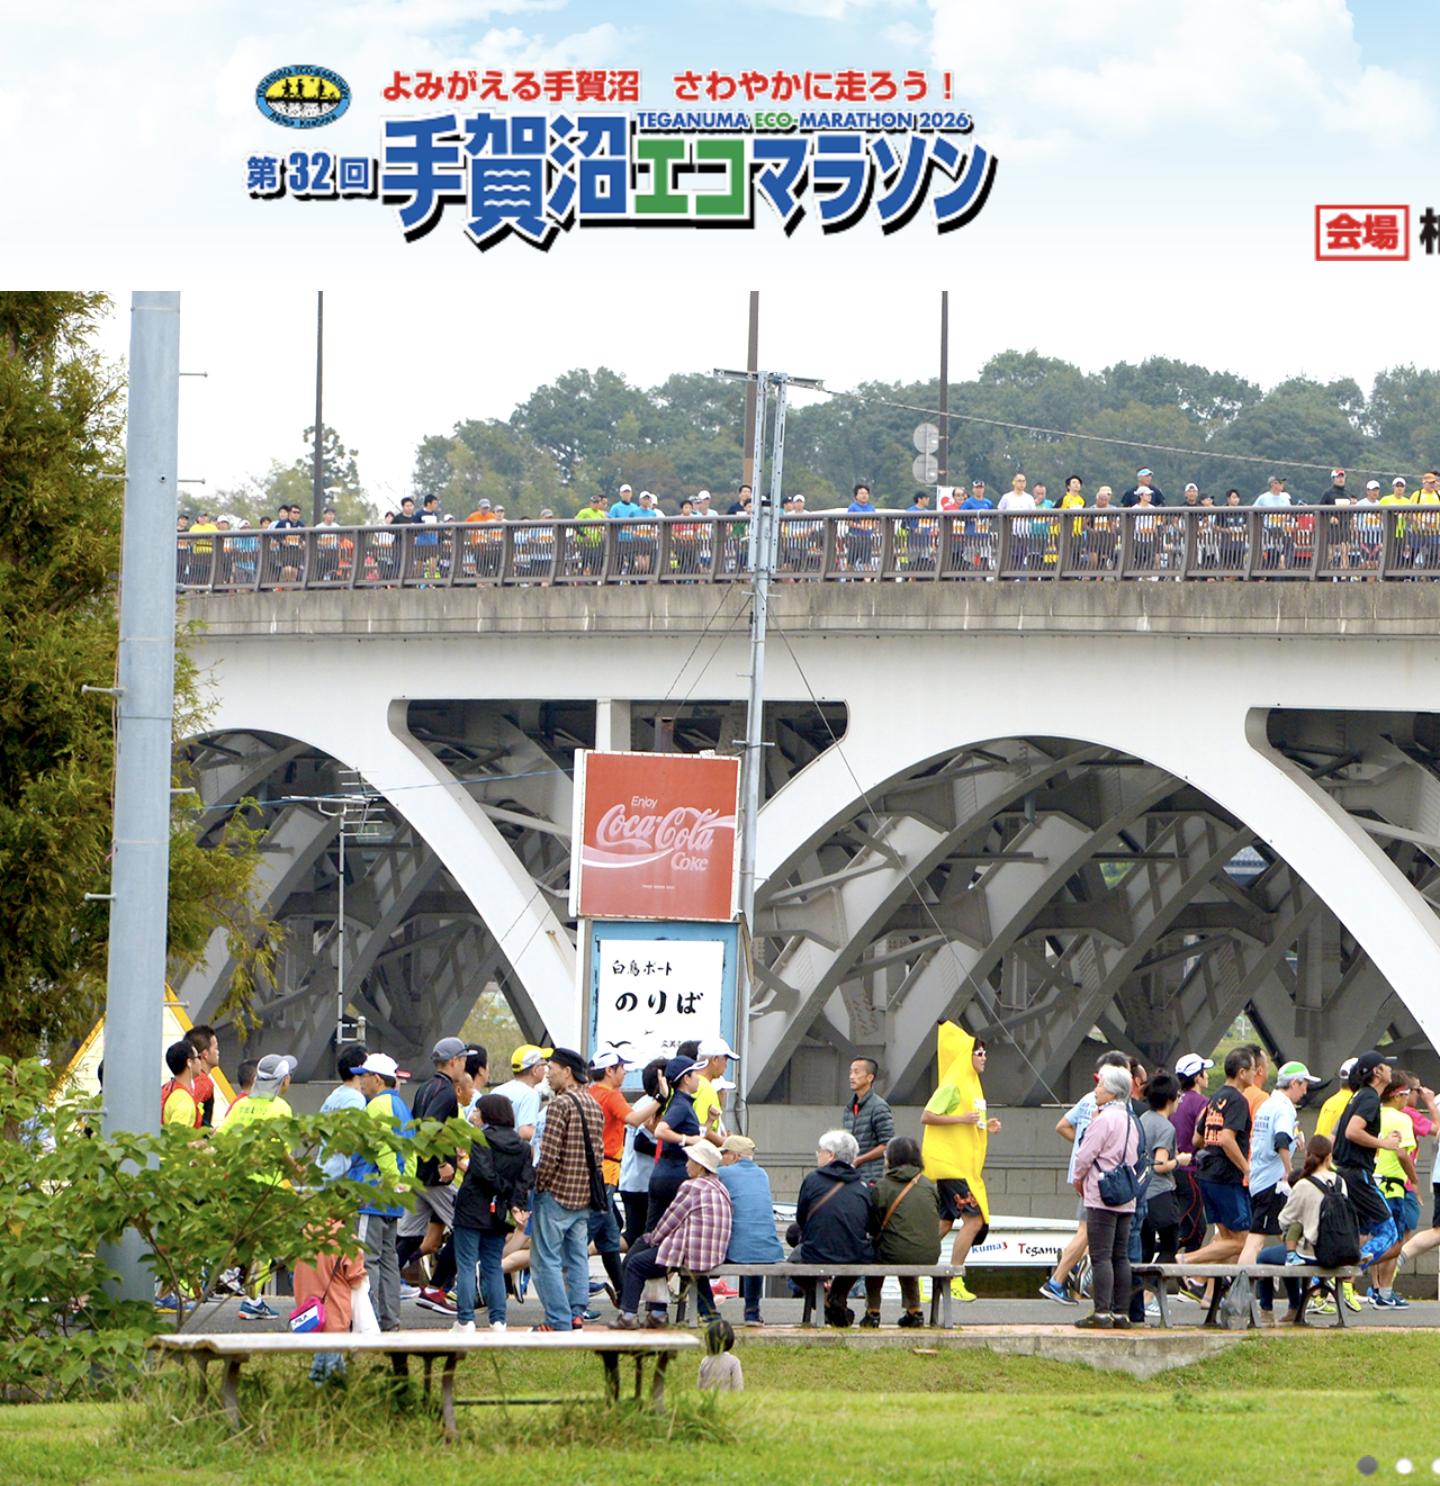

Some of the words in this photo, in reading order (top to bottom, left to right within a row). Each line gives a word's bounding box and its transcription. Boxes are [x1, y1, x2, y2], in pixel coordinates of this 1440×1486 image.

[631, 795, 658, 809] Enjoy
[596, 804, 720, 851] Coca-Cola
[671, 852, 709, 871] Coke
[615, 990, 704, 1015] のりば
